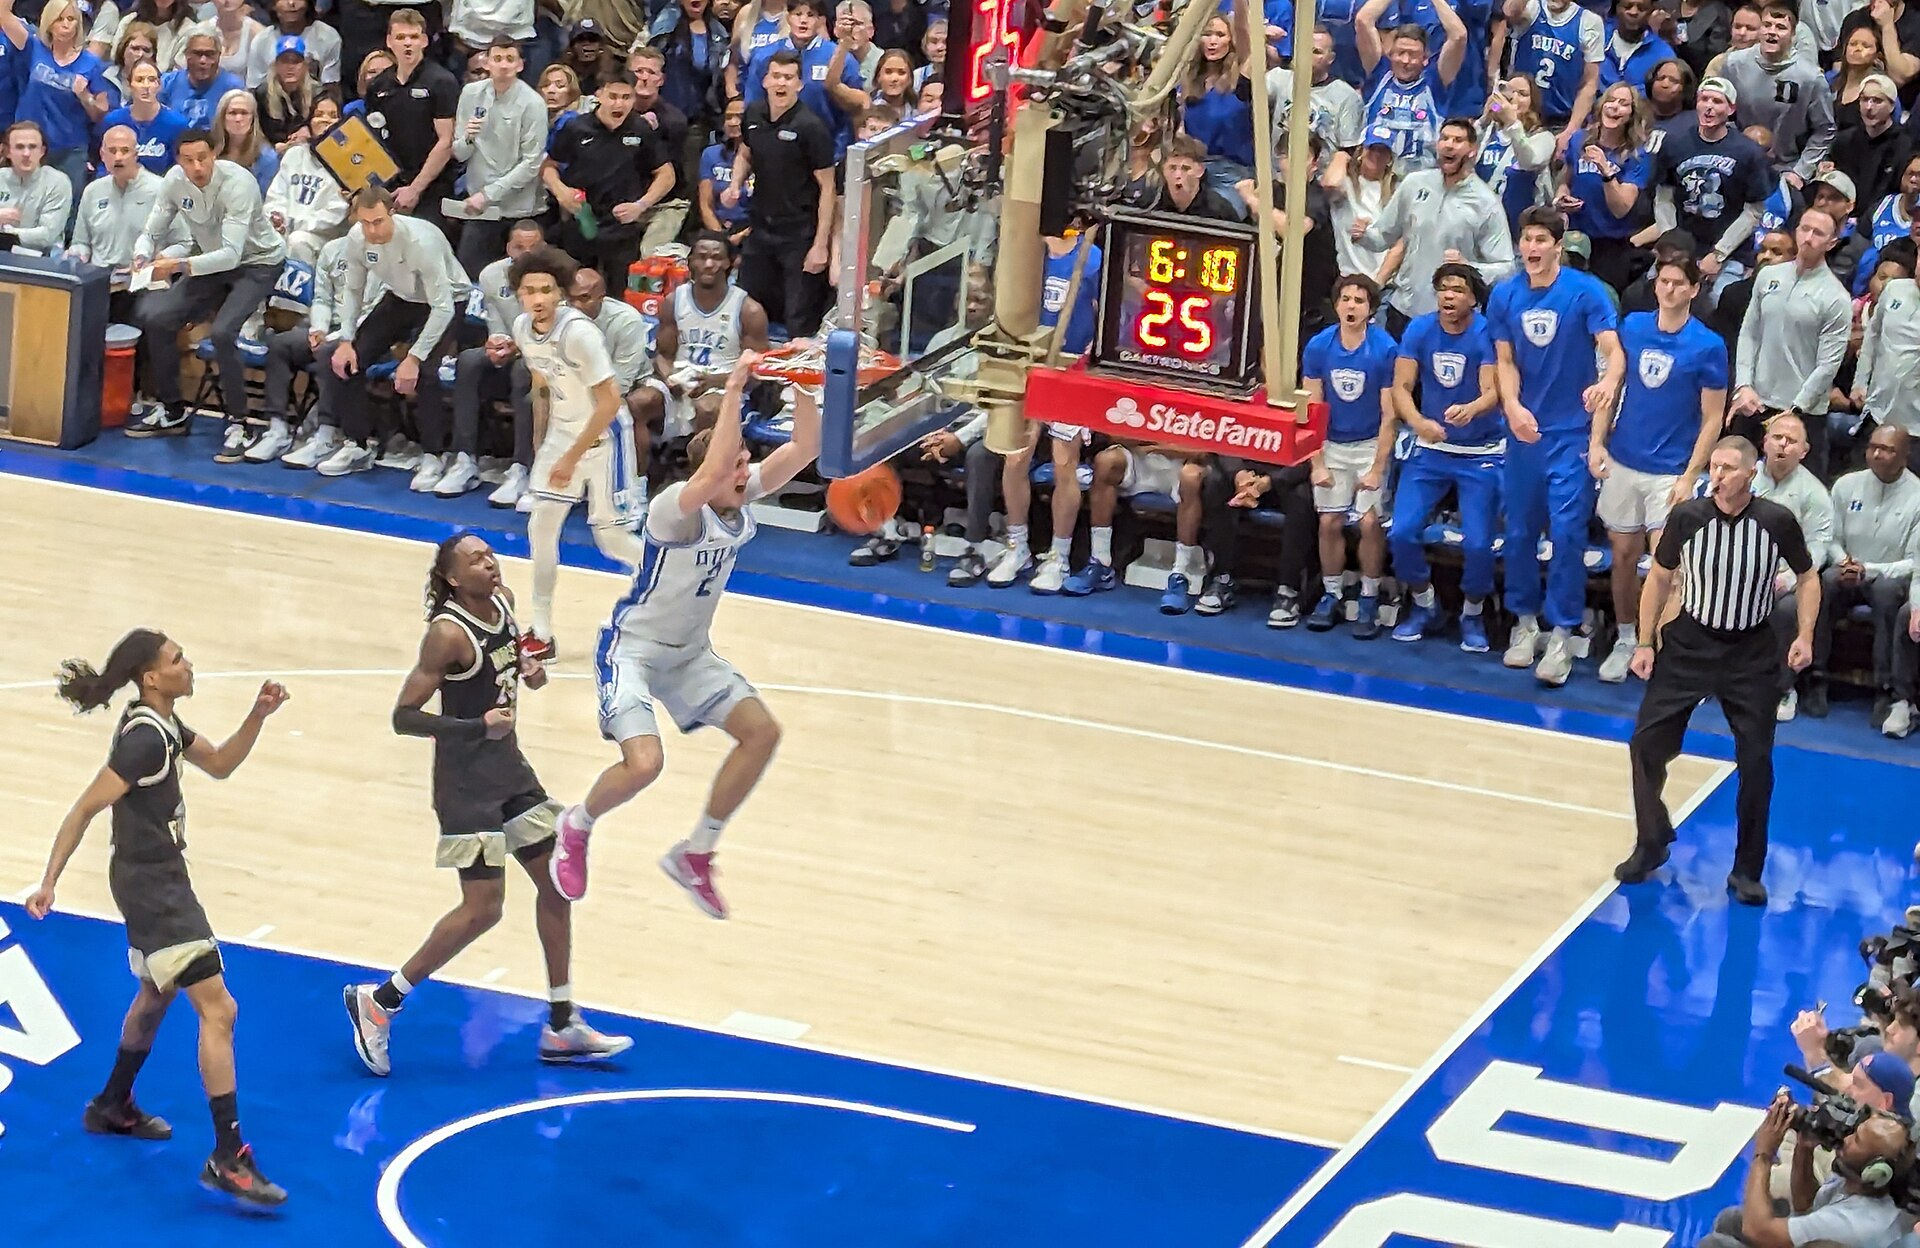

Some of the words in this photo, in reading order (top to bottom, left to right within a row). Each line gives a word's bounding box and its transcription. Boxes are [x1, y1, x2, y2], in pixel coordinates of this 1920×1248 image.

[1531, 34, 1576, 62] DUKE
[1534, 57, 1555, 90] 2
[1774, 78, 1800, 104] D
[1149, 240, 1238, 294] 6:10
[1139, 291, 1211, 353] 25
[695, 561, 722, 597] 2
